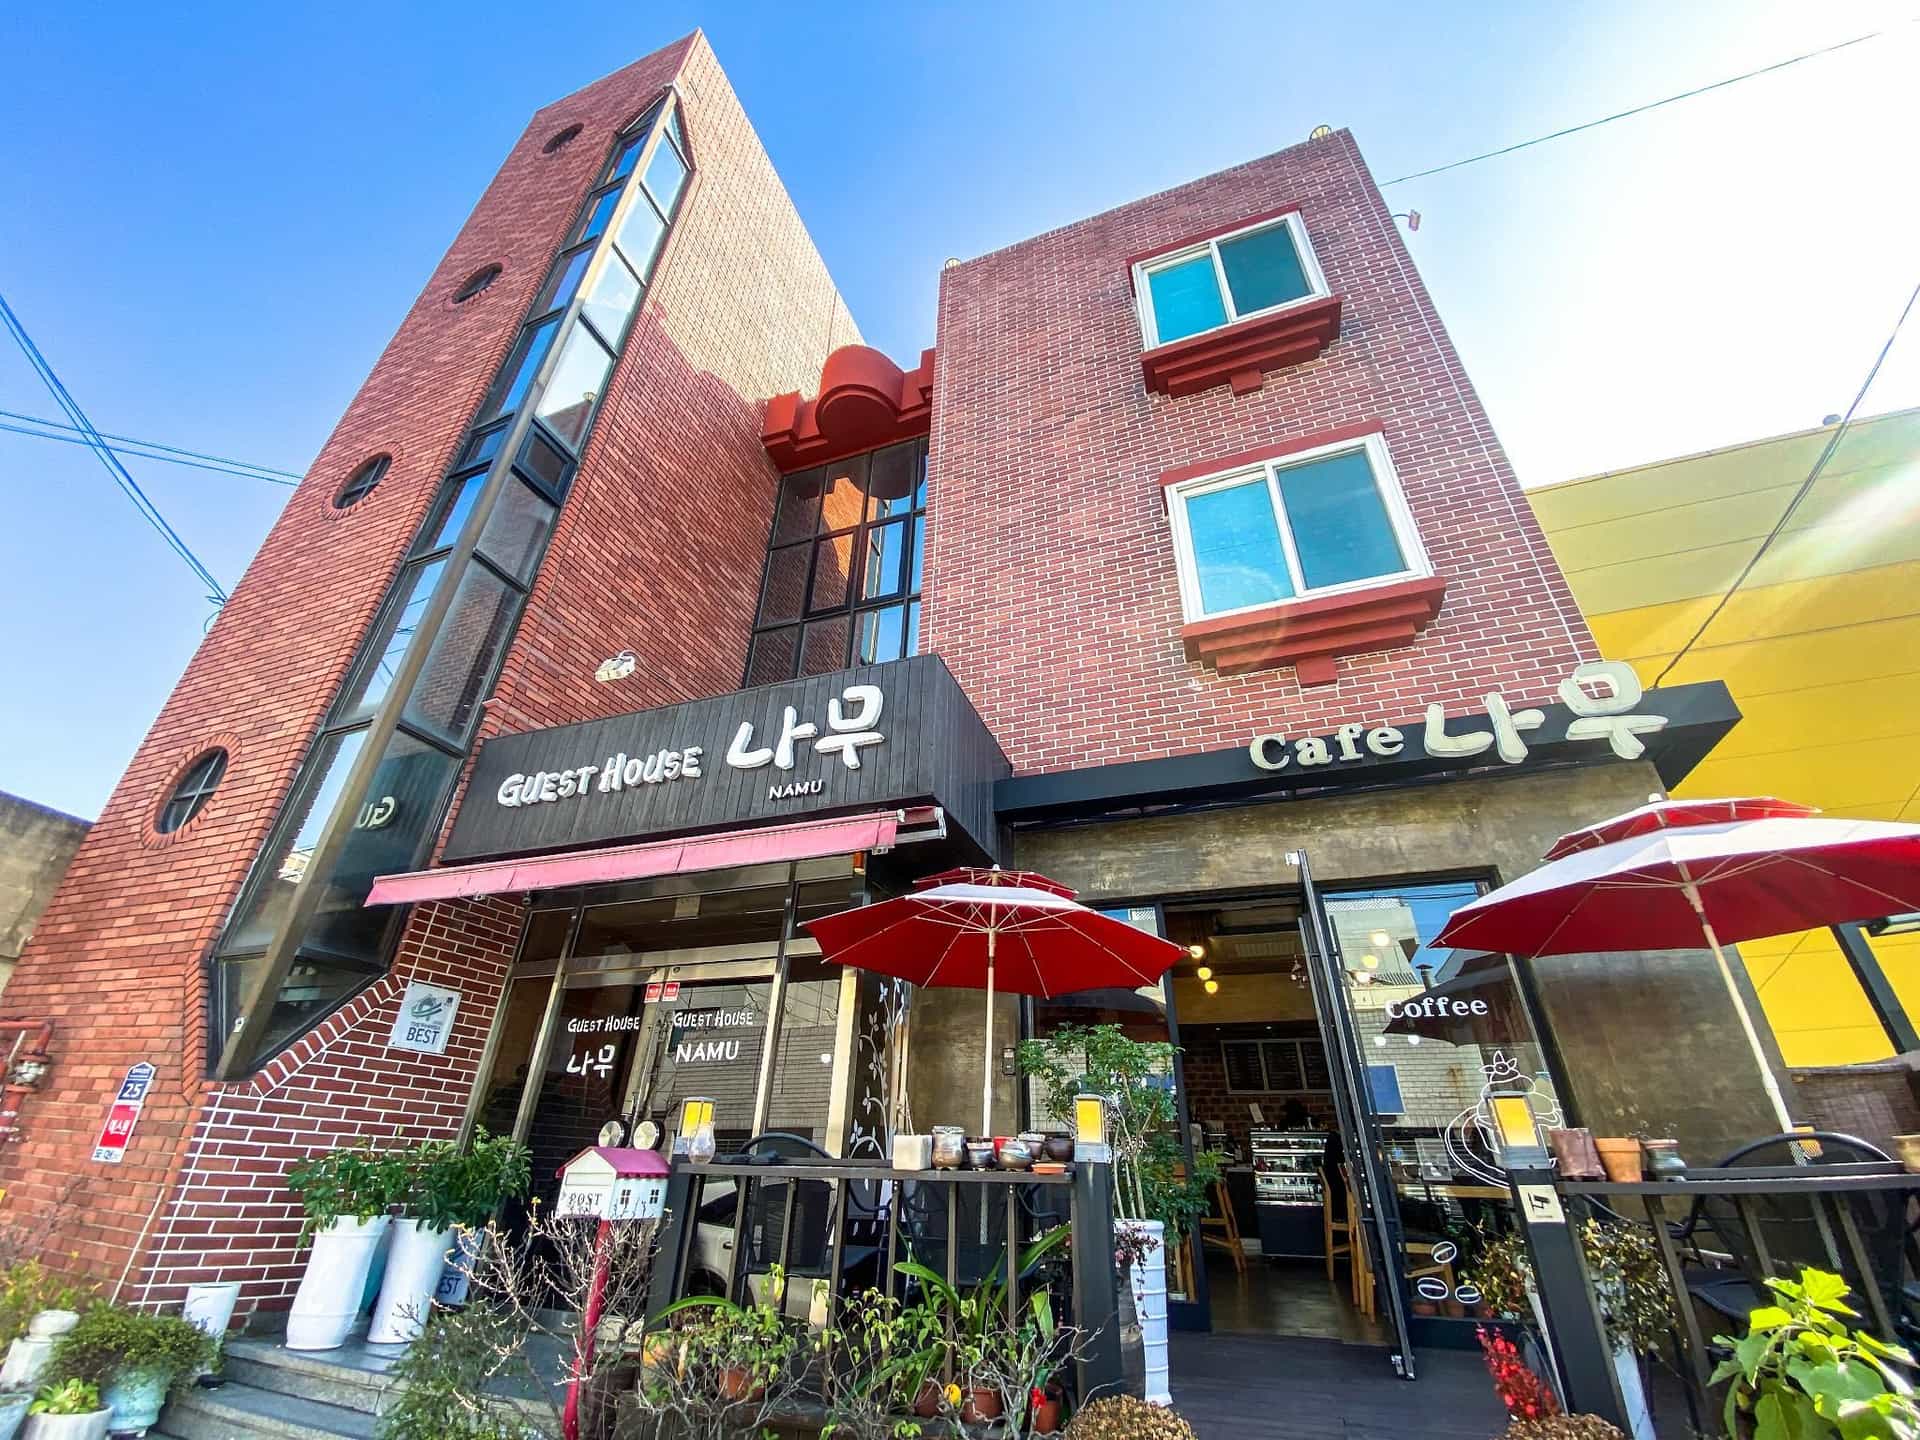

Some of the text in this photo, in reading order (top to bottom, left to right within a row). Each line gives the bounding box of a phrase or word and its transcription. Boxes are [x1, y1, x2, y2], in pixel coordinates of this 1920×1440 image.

[1250, 661, 1669, 771] Cafe 나무
[497, 685, 885, 808] GUEST HOUSE 나무
[769, 778, 825, 801] NAMU
[1384, 997, 1489, 1018] Coffee
[567, 1015, 641, 1033] GUEST HOUSE
[673, 1010, 754, 1028] GUEST HOUSE
[406, 1027, 441, 1045] BEST
[566, 1044, 616, 1078] 나무
[675, 1040, 740, 1064] NAMU
[122, 1083, 144, 1098] 25
[568, 1192, 603, 1206] POST
